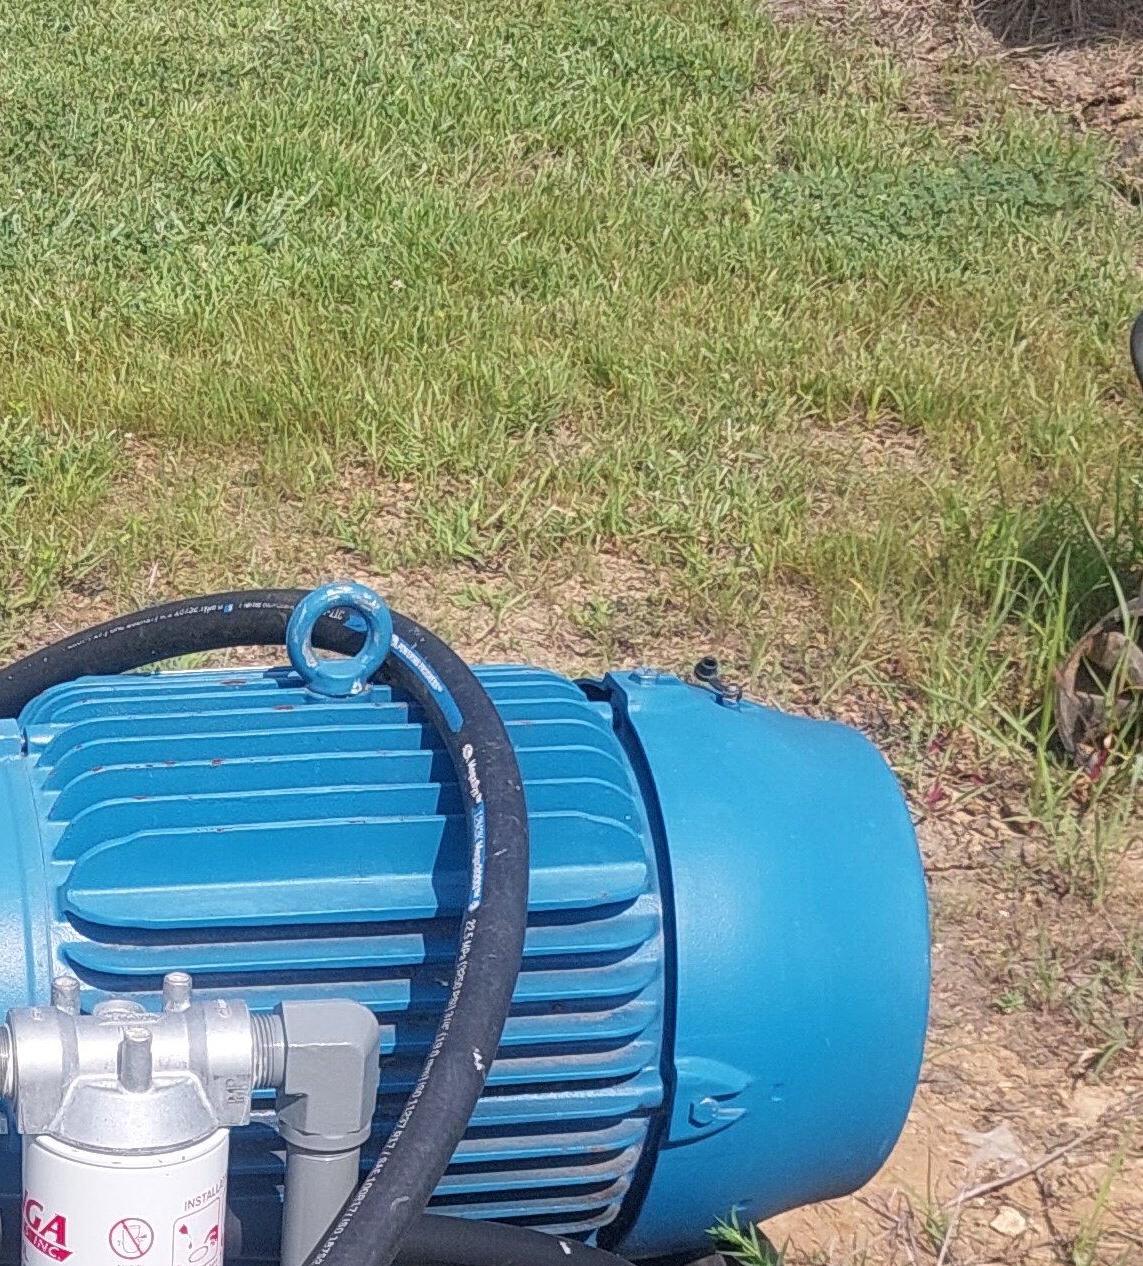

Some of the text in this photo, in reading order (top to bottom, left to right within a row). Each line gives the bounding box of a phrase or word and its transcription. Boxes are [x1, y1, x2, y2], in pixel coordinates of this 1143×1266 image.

[411, 1081, 428, 1098] ISO
[372, 1156, 388, 1175] SAE
[184, 1173, 228, 1212] INSTALLA
[33, 1234, 62, 1260] INC.
